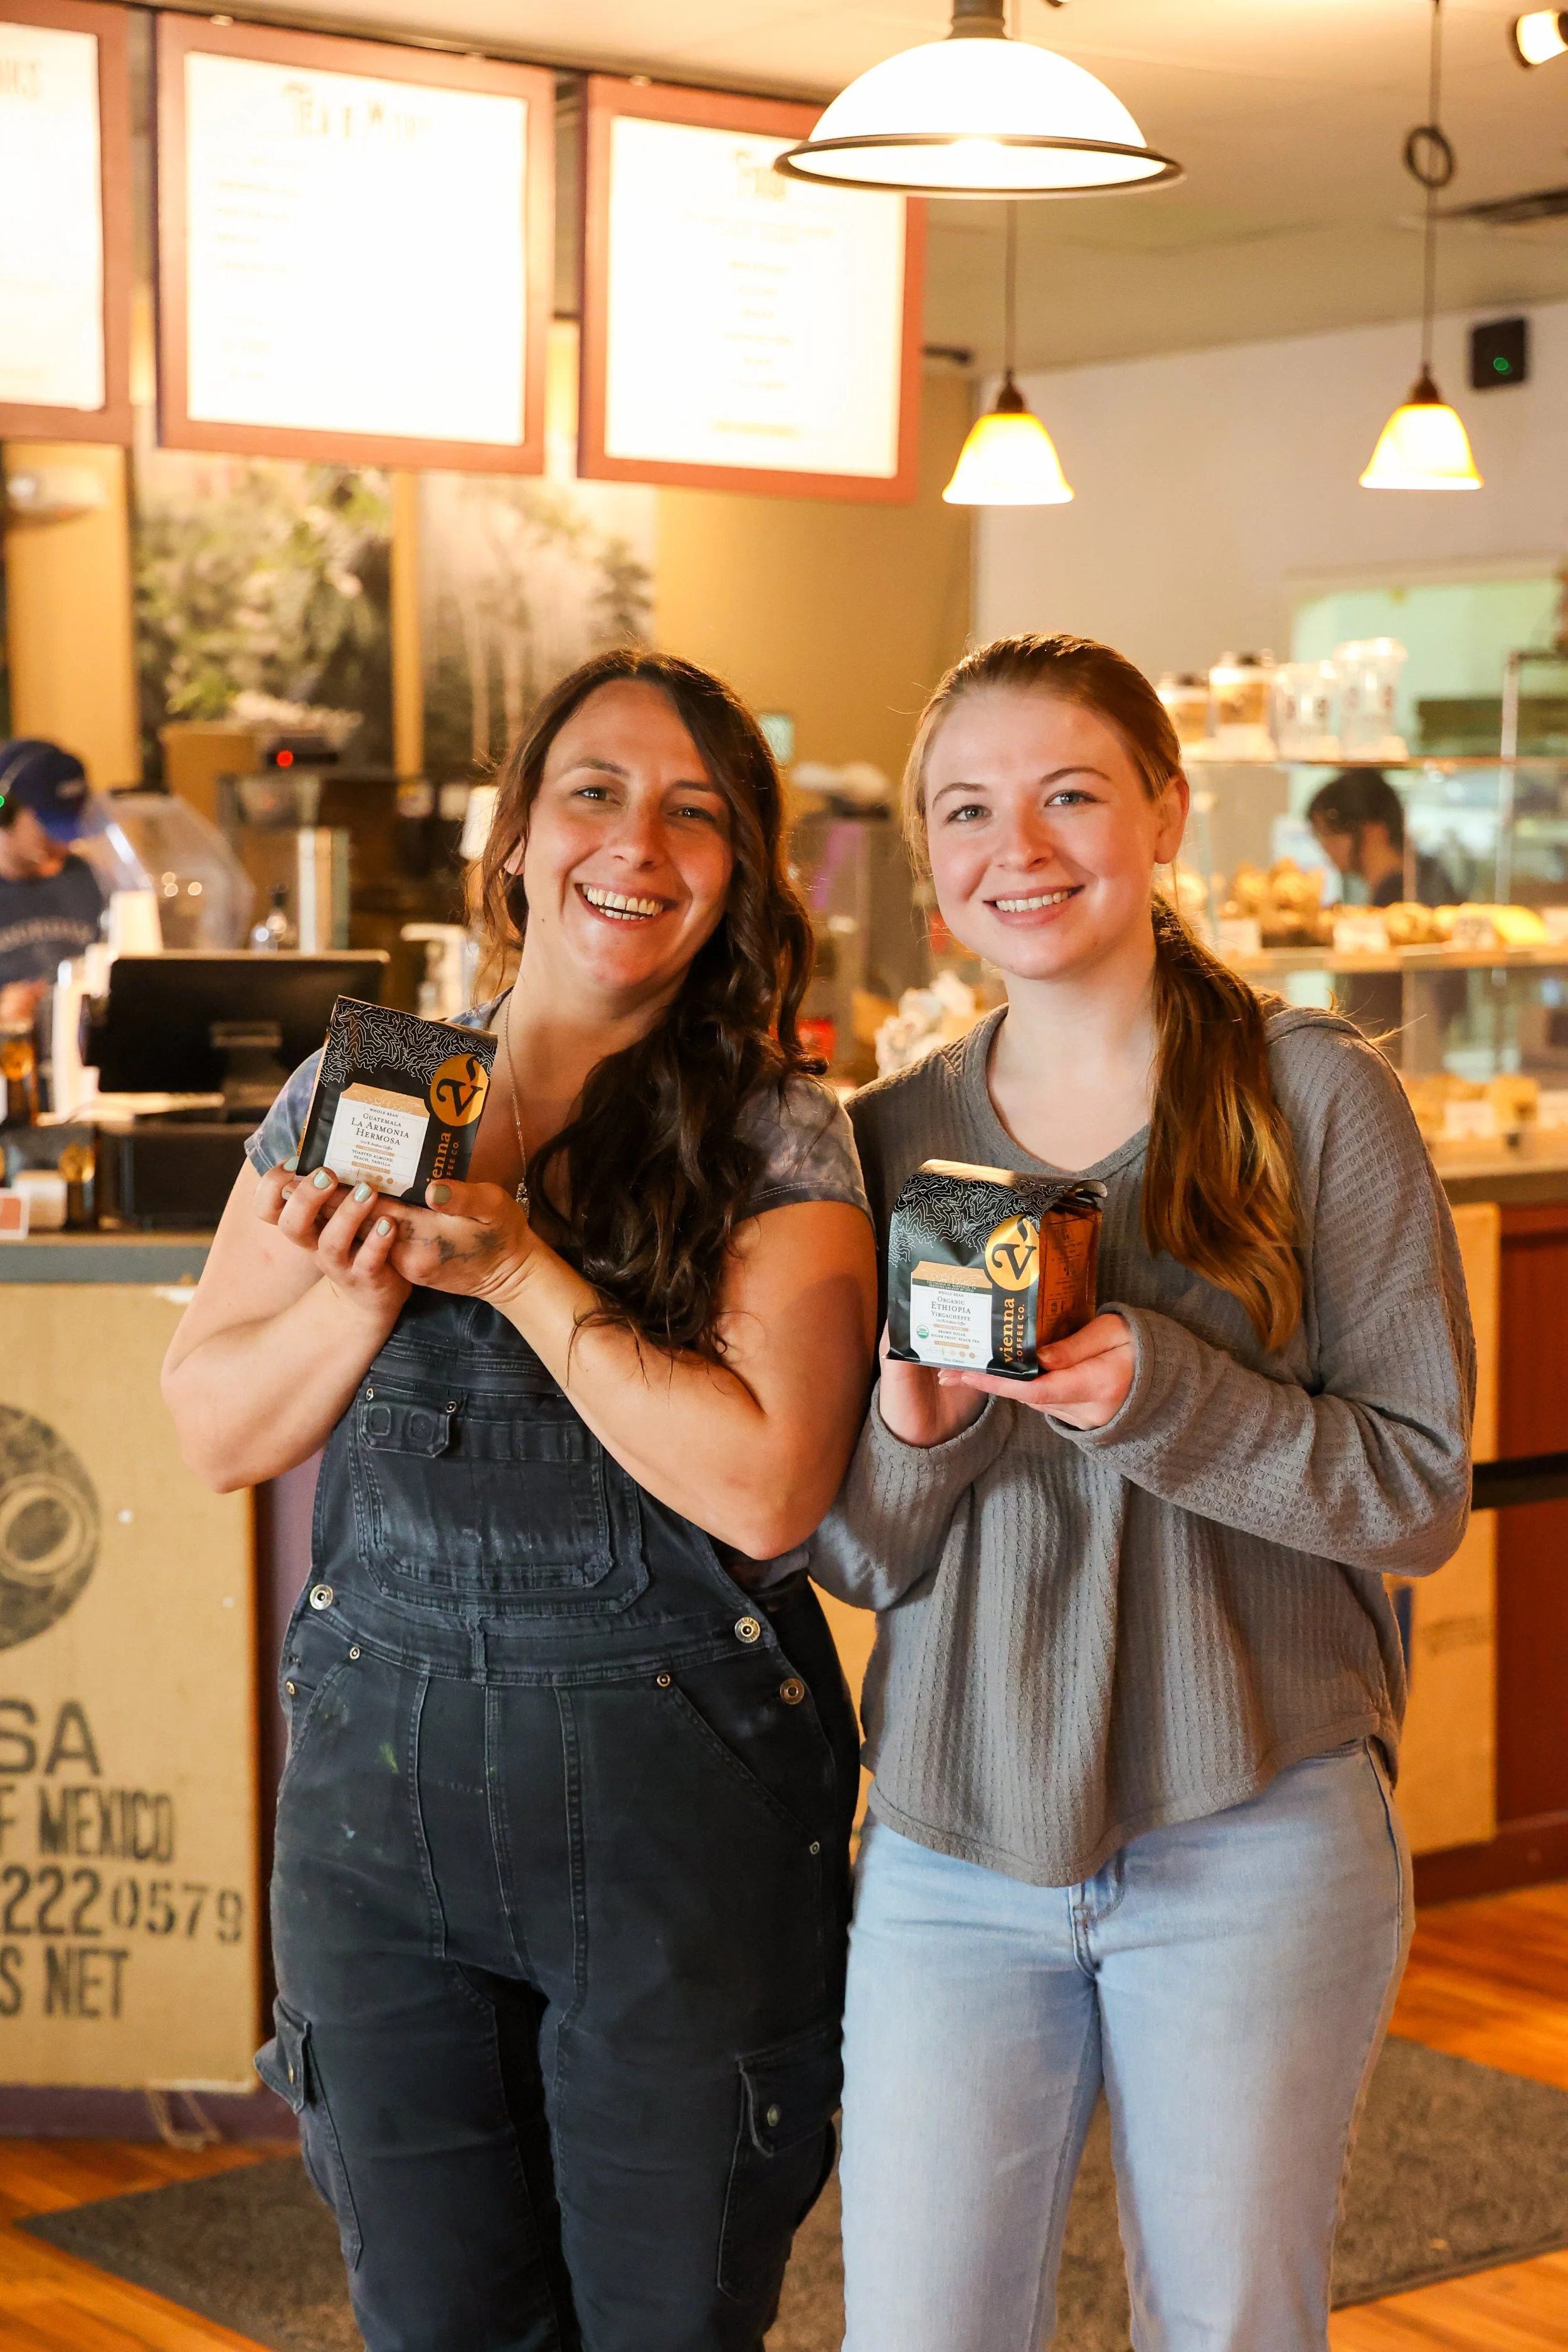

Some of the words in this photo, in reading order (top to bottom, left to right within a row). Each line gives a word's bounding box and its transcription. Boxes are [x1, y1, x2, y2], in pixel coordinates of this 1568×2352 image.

[351, 1118, 363, 1126] LA
[366, 1121, 409, 1138] ARMONIA
[363, 1113, 401, 1127] GUATEMALA
[356, 1128, 400, 1145] HERMOSA
[374, 1155, 394, 1163] ALMOND,
[426, 1132, 452, 1182] enna
[931, 1301, 971, 1314] ETHIOPIA
[937, 1296, 965, 1305] ORGANIC
[931, 1310, 971, 1321] YIRGACHEFFE
[999, 1298, 1015, 1362] vienna
[39, 1785, 174, 1863] MEXICO
[45, 1947, 129, 2017] NET
